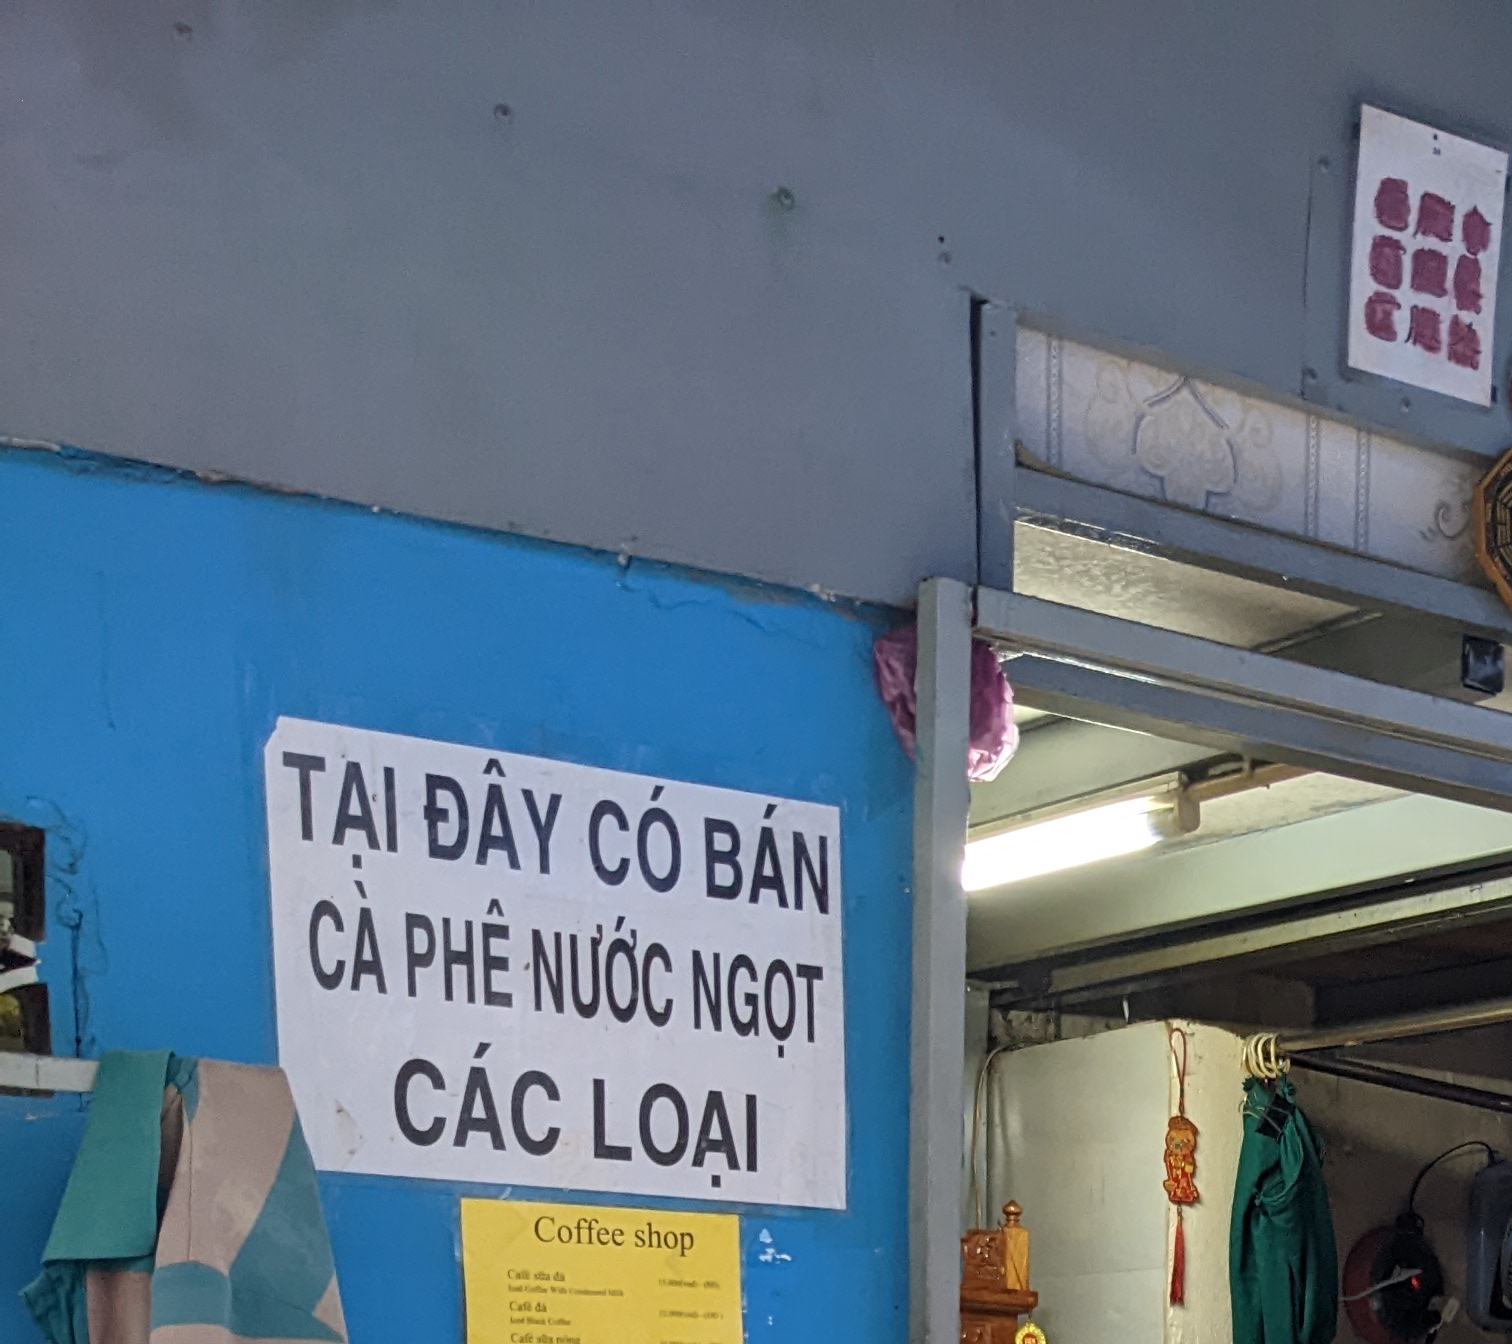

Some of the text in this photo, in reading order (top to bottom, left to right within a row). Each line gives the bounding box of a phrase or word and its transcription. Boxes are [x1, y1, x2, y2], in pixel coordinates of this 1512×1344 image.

[282, 750, 829, 915] TẠI ĐÂY CÓ BÁN
[308, 879, 824, 1059] CÀ PHÊ NƯỚC NGỌT
[393, 1042, 758, 1188] CÁC LOẠI
[534, 1215, 695, 1257] Coffee shop
